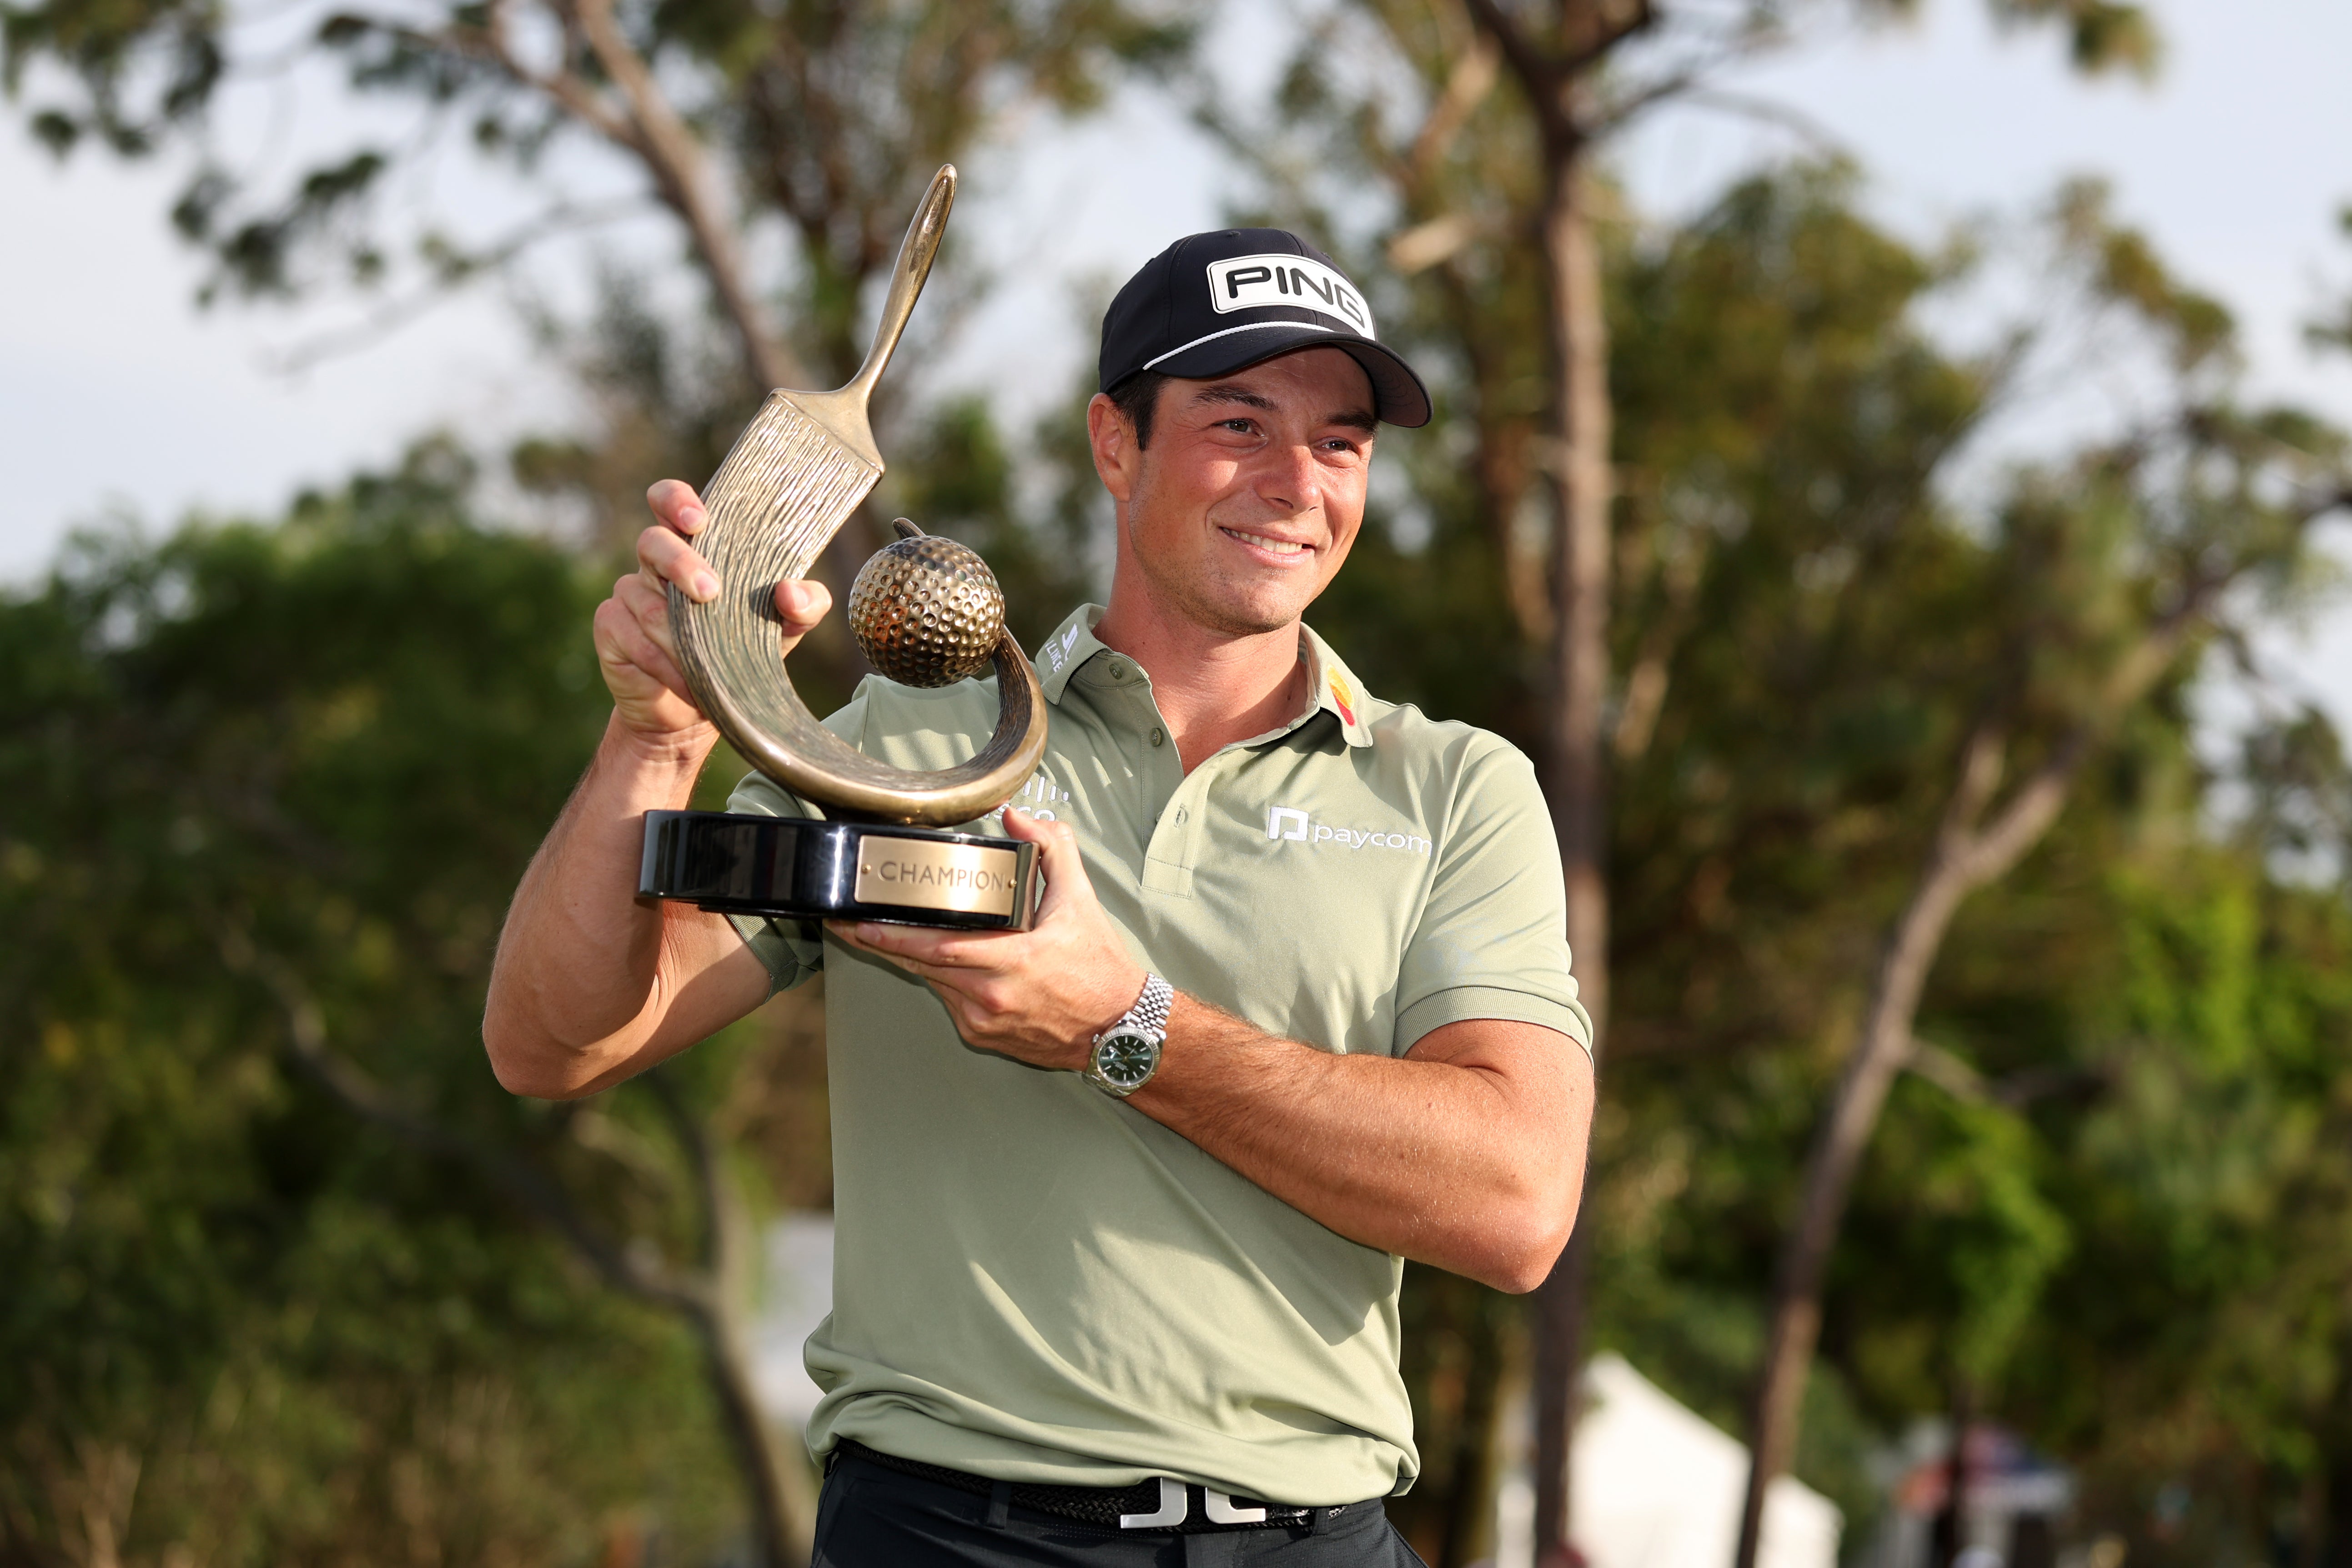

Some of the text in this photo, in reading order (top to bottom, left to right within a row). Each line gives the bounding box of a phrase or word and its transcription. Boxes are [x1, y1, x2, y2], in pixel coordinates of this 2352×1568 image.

[1226, 266, 1365, 329] PING
[1313, 824, 1432, 857] paycom
[878, 860, 1005, 891] CHAMPION
